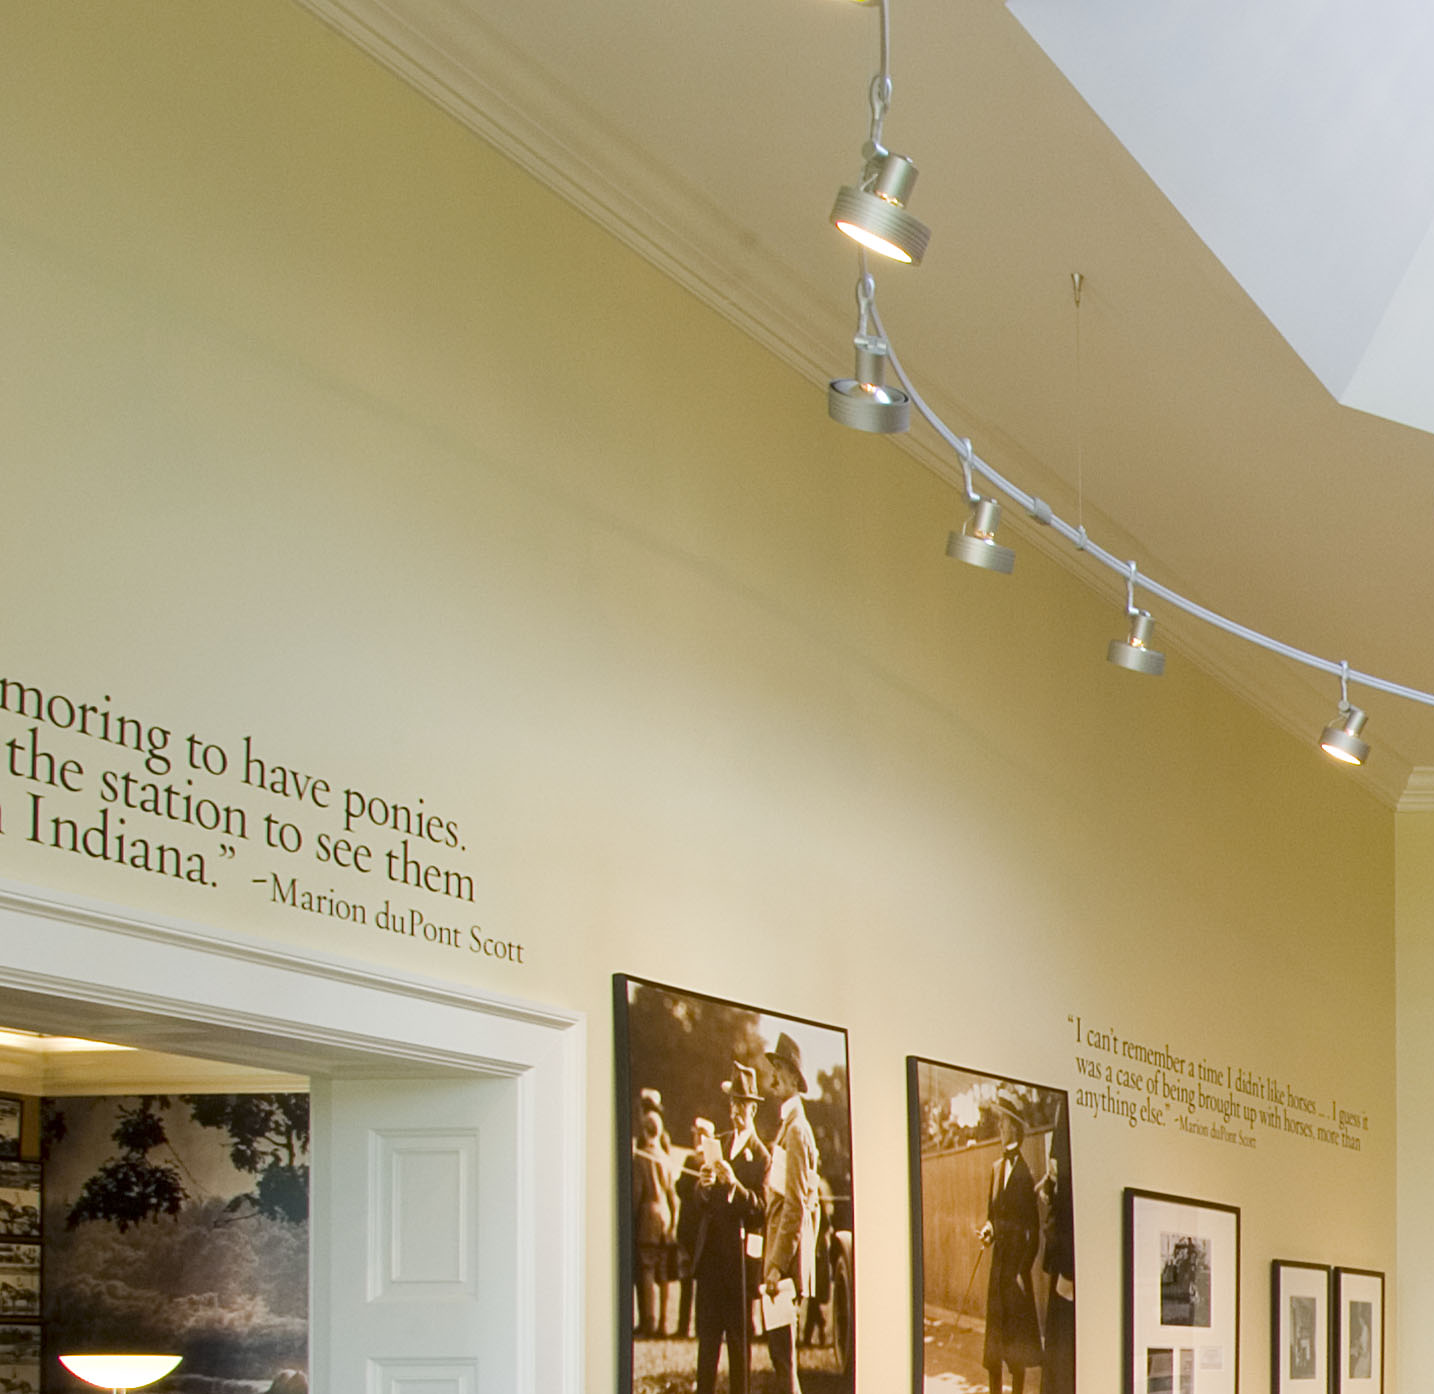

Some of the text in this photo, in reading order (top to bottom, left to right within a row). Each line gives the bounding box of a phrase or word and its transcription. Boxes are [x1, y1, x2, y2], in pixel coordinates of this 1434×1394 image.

[0, 678, 466, 851] moring to have ponies.
[6, 727, 474, 902] the station to see them
[26, 792, 235, 887] Indiana.”
[375, 900, 461, 948] duPont
[470, 926, 524, 963] Scott
[1075, 1057, 1102, 1079] was
[1106, 1066, 1112, 1083] a
[1116, 1069, 1143, 1091] case
[1146, 1069, 1161, 1095] of
[1163, 1072, 1196, 1114] being
[1198, 1083, 1240, 1123] brought
[1244, 1106, 1257, 1130] up
[1259, 1106, 1281, 1130] with
[1318, 1128, 1339, 1145] more
[1342, 1127, 1360, 1151] than
[1076, 1085, 1137, 1128] anything
[1087, 1028, 1118, 1054] can’t
[1122, 1041, 1186, 1074] remember
[1188, 1062, 1194, 1078] a
[1198, 1059, 1223, 1086] time
[1227, 1066, 1232, 1088] I
[1235, 1068, 1264, 1099] didn’t
[1267, 1078, 1285, 1105] like
[1287, 1084, 1316, 1114] horses
[1332, 1100, 1337, 1121] I
[1339, 1110, 1360, 1130] guess
[1363, 1110, 1369, 1131] it
